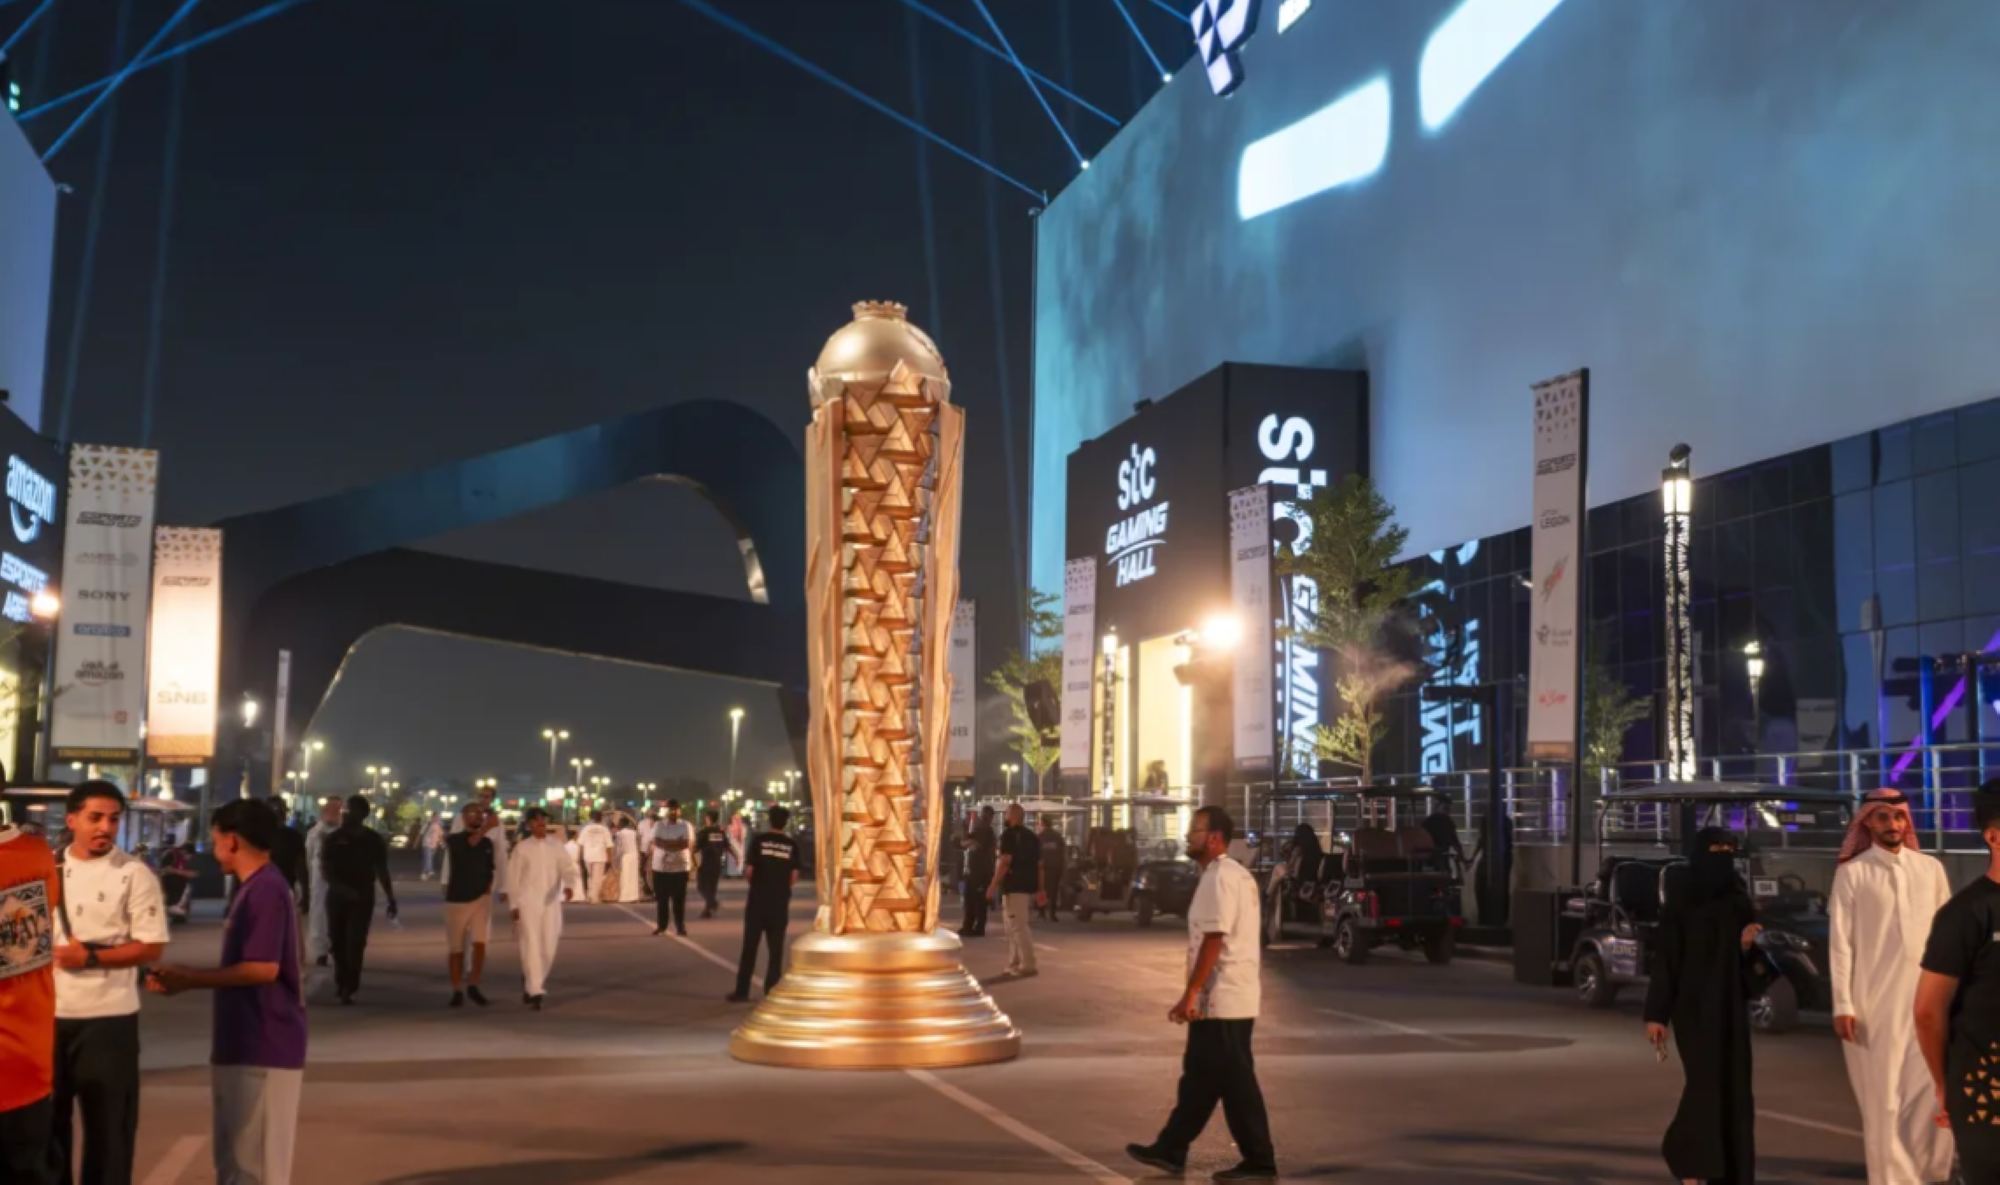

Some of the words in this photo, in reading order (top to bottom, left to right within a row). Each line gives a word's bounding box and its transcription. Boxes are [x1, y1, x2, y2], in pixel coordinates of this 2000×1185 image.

[6, 453, 57, 525] amazon
[1117, 443, 1157, 511] stc
[1105, 501, 1170, 555] GAMING
[0, 551, 49, 595] ESPORTS
[1116, 547, 1157, 588] HALL
[78, 590, 130, 600] SONY
[75, 669, 124, 680] amazon
[1292, 574, 1318, 780] GAMING
[158, 691, 208, 705] SNB
